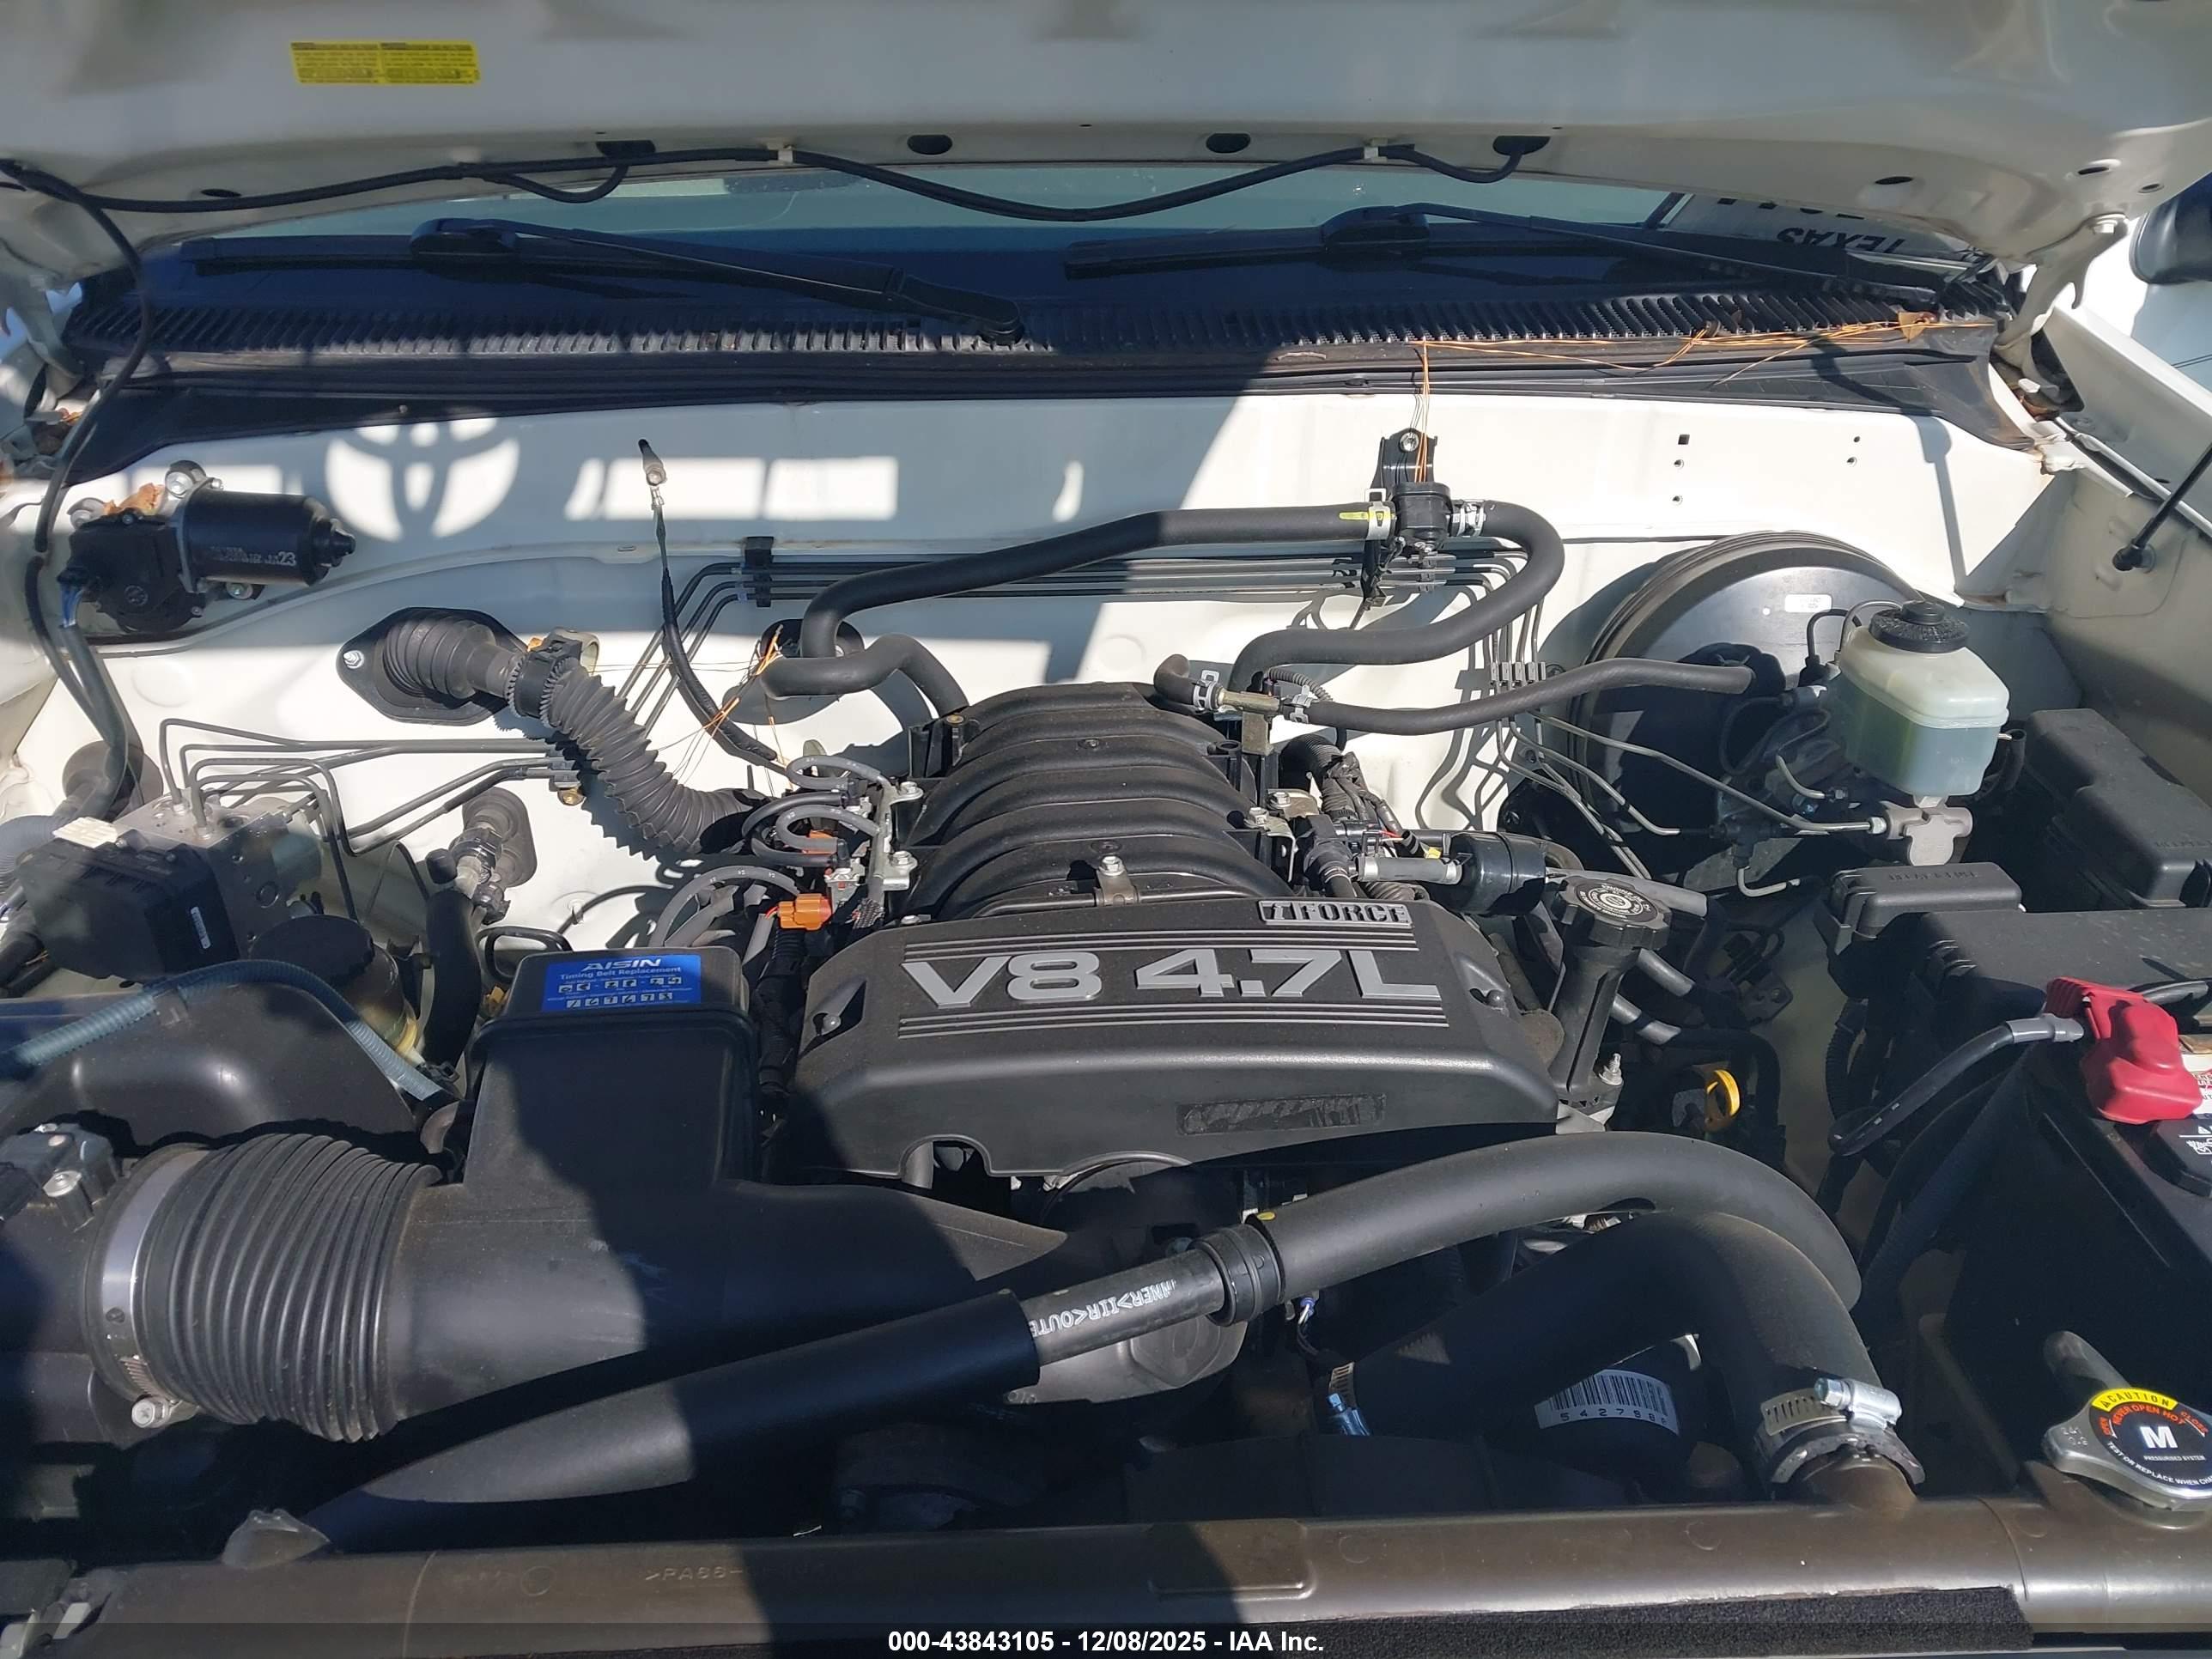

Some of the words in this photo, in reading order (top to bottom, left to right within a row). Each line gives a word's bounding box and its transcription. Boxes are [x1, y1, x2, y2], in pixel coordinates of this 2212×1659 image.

[1777, 227, 1906, 254] TEXAS
[561, 972, 594, 981] Timing
[597, 969, 616, 977] Belt
[618, 967, 682, 975] Replacement
[580, 958, 661, 972] AISIN
[901, 951, 1103, 1009] V8
[1135, 948, 1443, 1001] 4.7L
[2107, 1392, 2171, 1407] CAUTION
[2130, 1403, 2160, 1414] OPEN
[2162, 1410, 2186, 1425] HOT
[2139, 1425, 2179, 1449] M
[2107, 1441, 2124, 1456] TEST
[2123, 1455, 2136, 1466] OR
[2135, 1464, 2175, 1483] REPLACE
